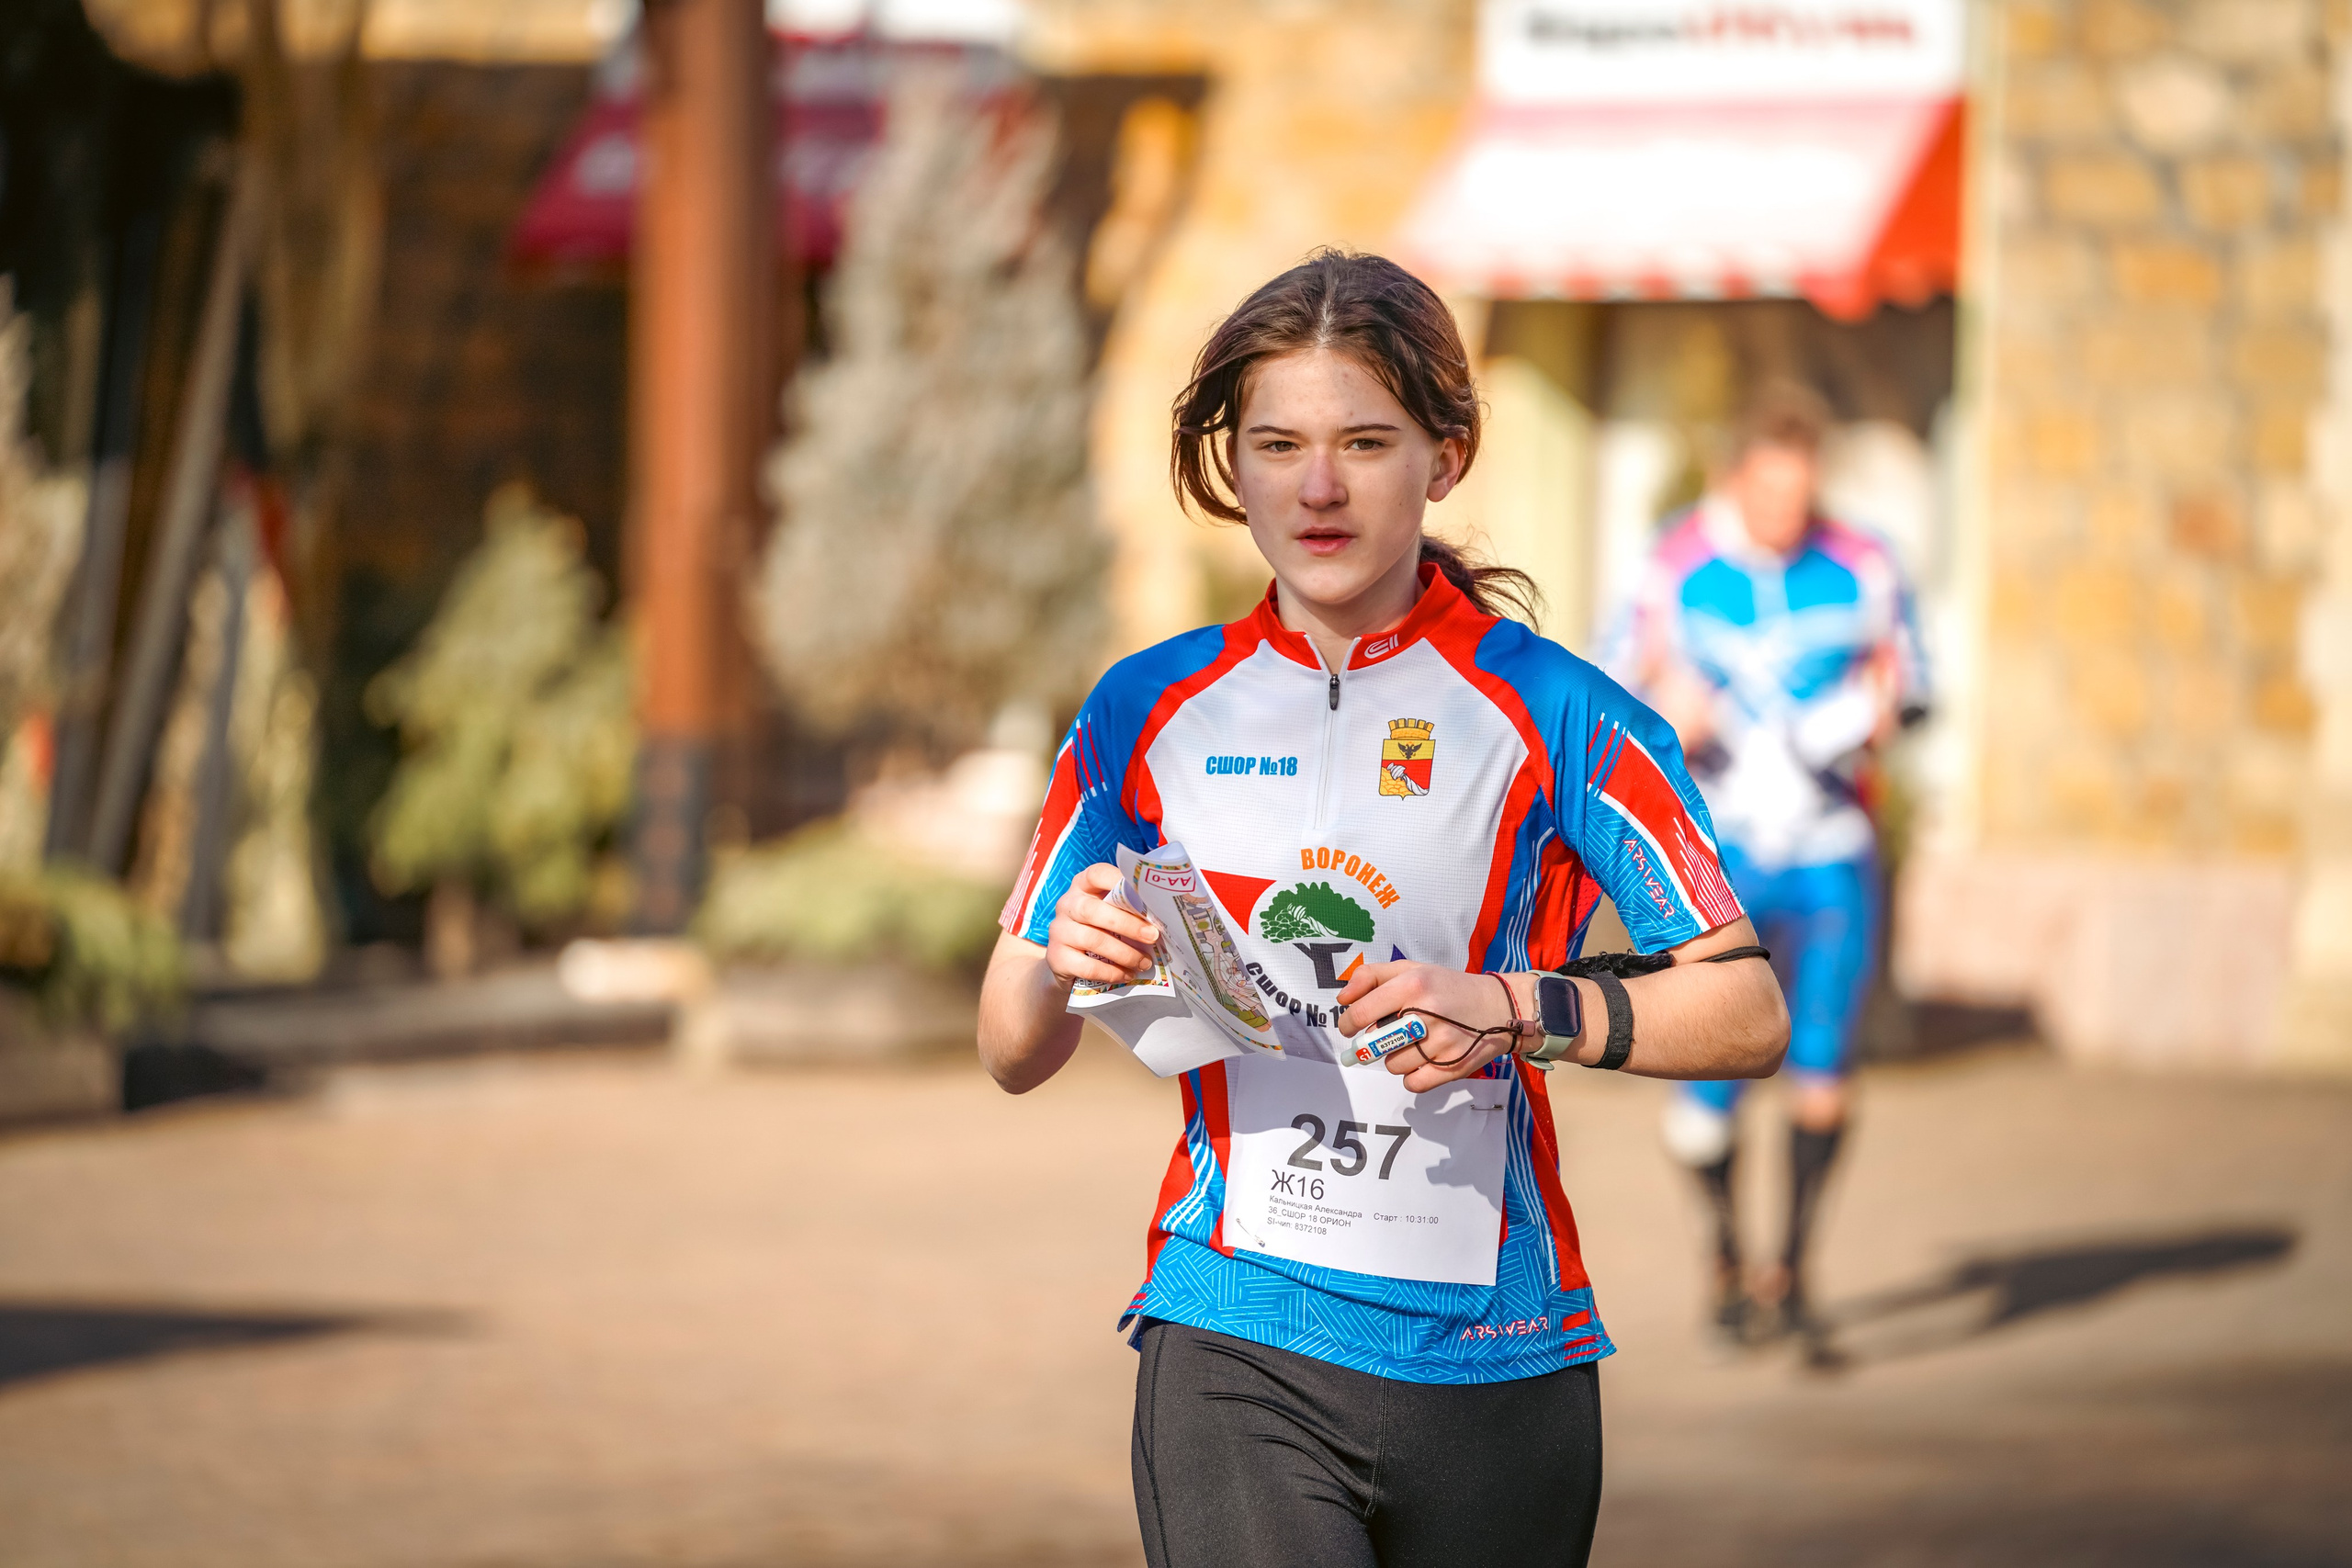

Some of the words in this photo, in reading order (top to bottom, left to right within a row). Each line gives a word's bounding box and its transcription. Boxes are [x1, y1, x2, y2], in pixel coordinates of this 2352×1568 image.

[1205, 755, 1256, 774] СШОР
[1259, 756, 1297, 776] №18
[1301, 847, 1401, 909] ВОРОНЕЖ
[1245, 961, 1302, 1015] СШОР
[1380, 1035, 1405, 1049] 8372108
[1286, 1113, 1412, 1180] 257
[1270, 1168, 1325, 1200] Ж16
[1269, 1194, 1313, 1212] Кальницкая
[1315, 1203, 1363, 1219] Александра
[1266, 1216, 1293, 1229] SI-чип:
[1295, 1223, 1328, 1235] 8372108
[1308, 1214, 1317, 1223] 18
[1319, 1215, 1351, 1228] ОРИОН
[1405, 1214, 1439, 1224] 10:31:00
